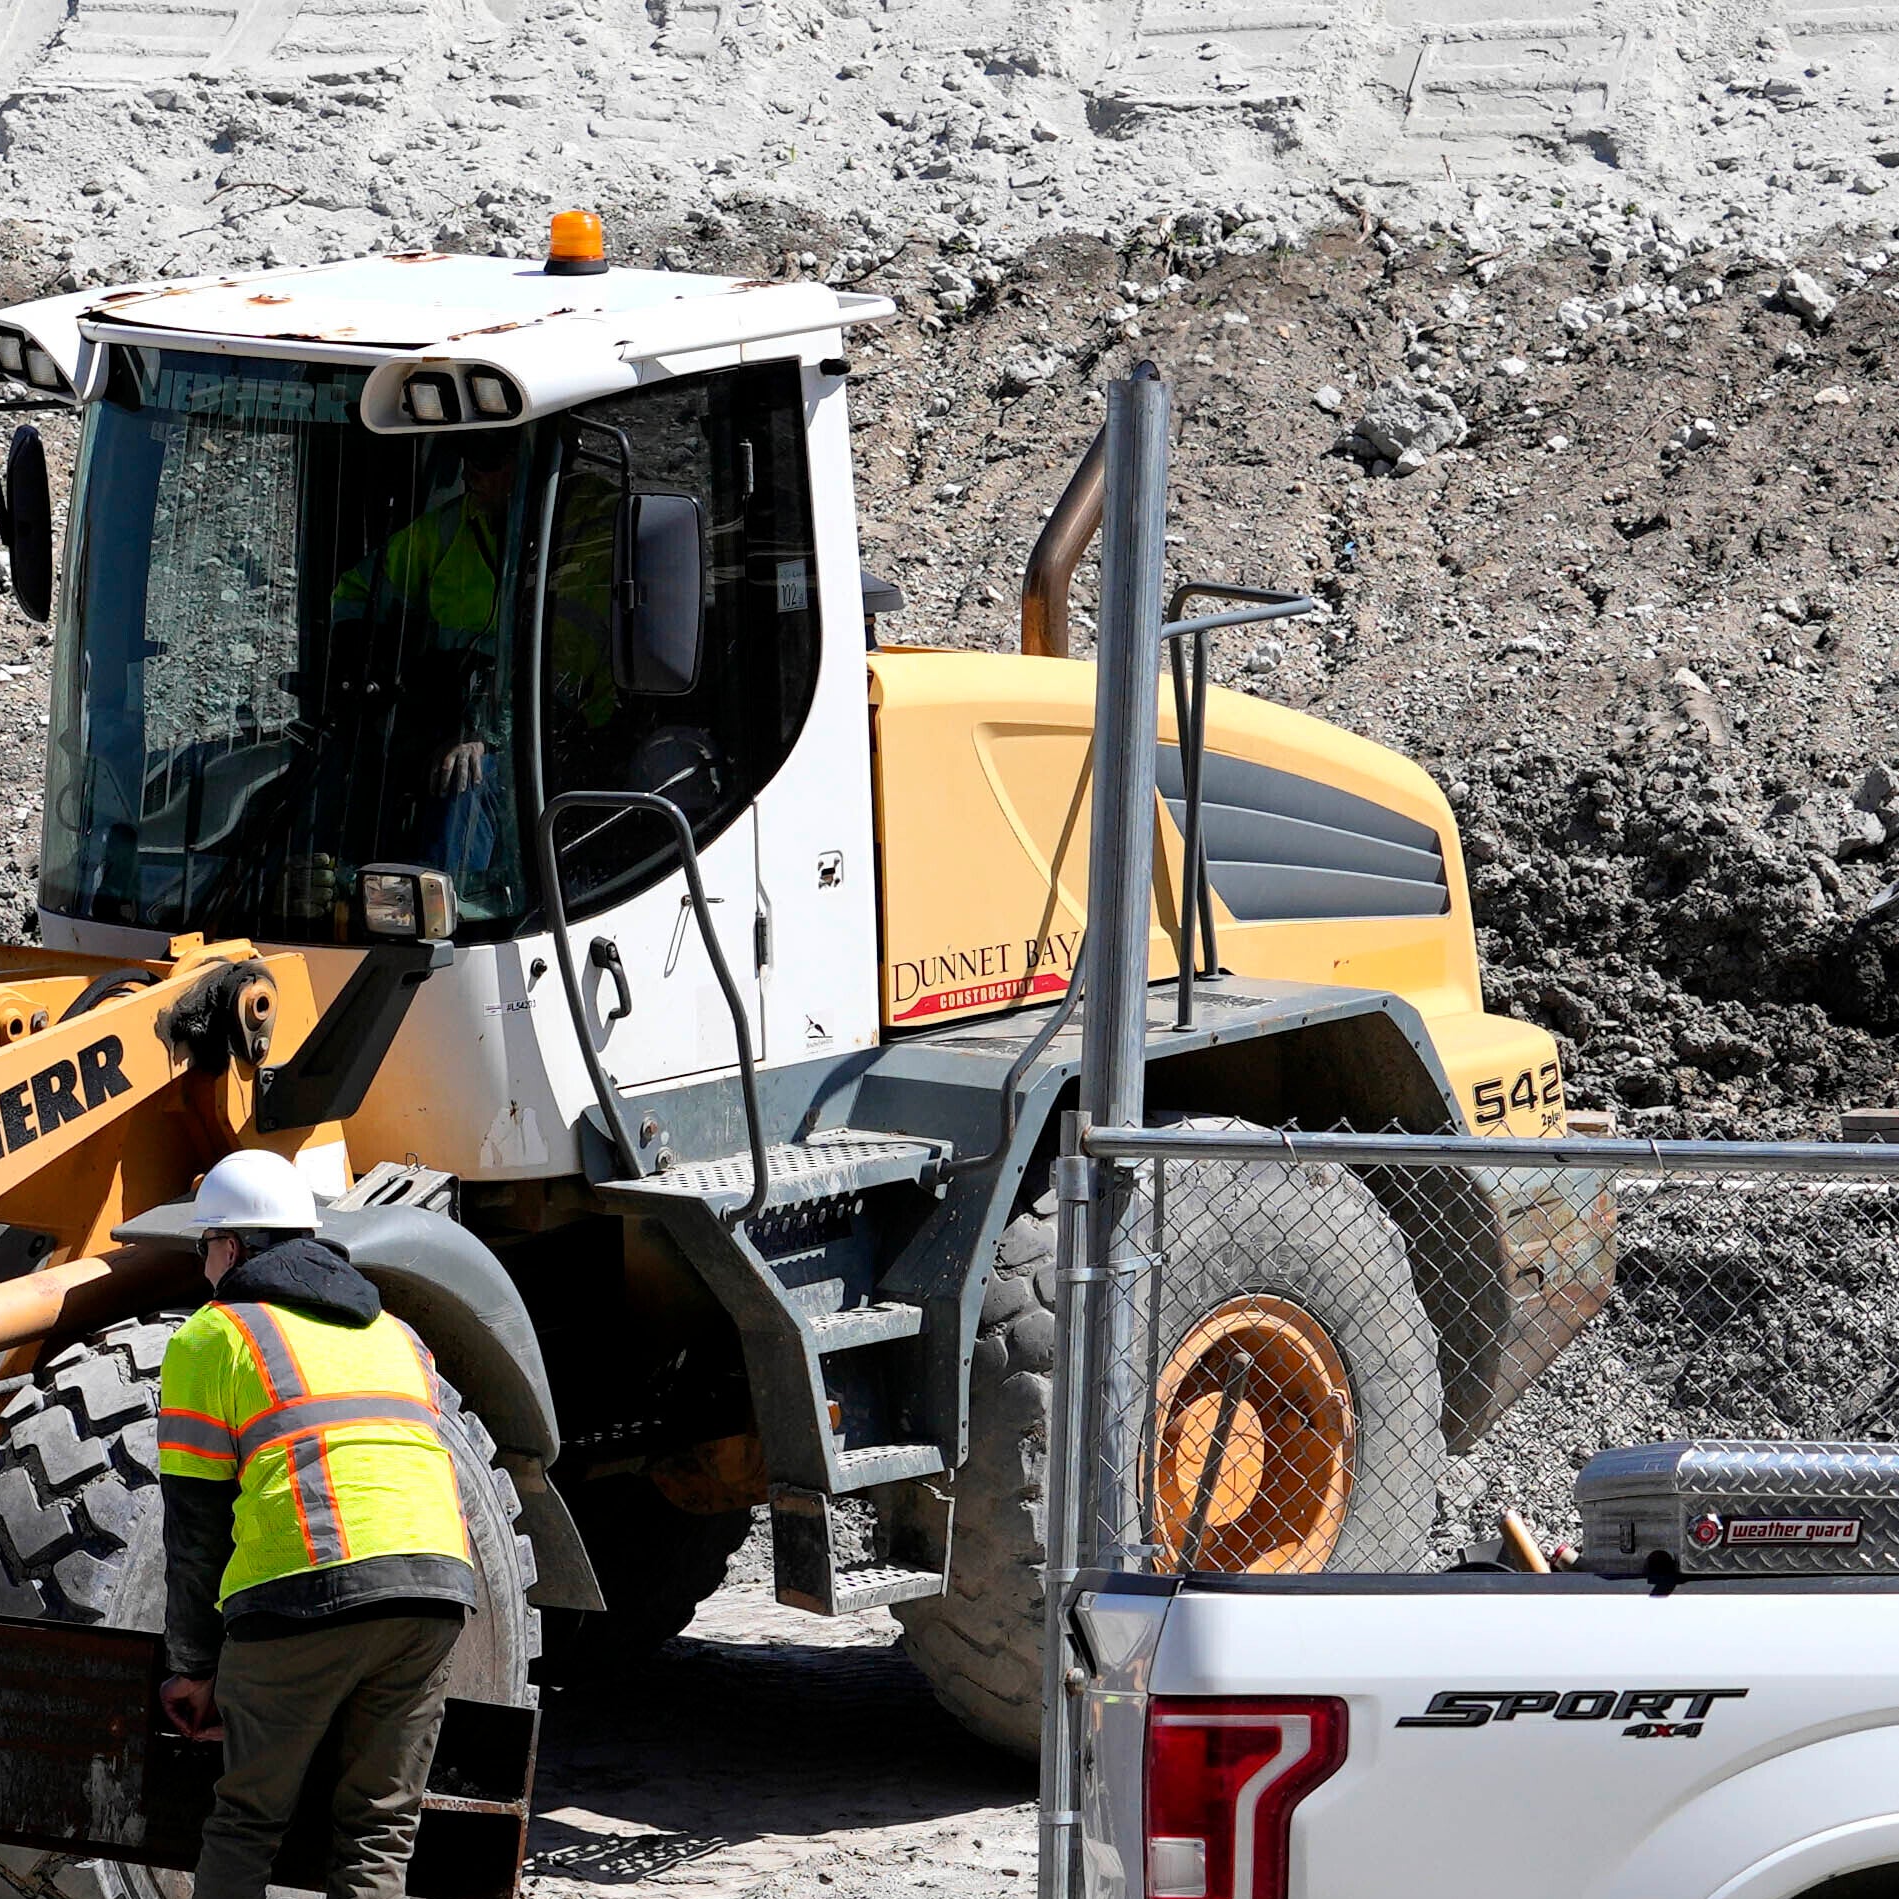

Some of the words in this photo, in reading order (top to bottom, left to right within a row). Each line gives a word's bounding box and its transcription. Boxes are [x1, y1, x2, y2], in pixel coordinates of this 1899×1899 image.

[892, 943, 1011, 1003] DUNNET
[1025, 931, 1080, 972] BAY
[939, 979, 1035, 1010] CONSTRUCTION
[1473, 1061, 1563, 1125] 542
[1732, 1522, 1802, 1538] weather
[1805, 1522, 1854, 1541] guard
[1395, 1688, 1750, 1729] SPORT
